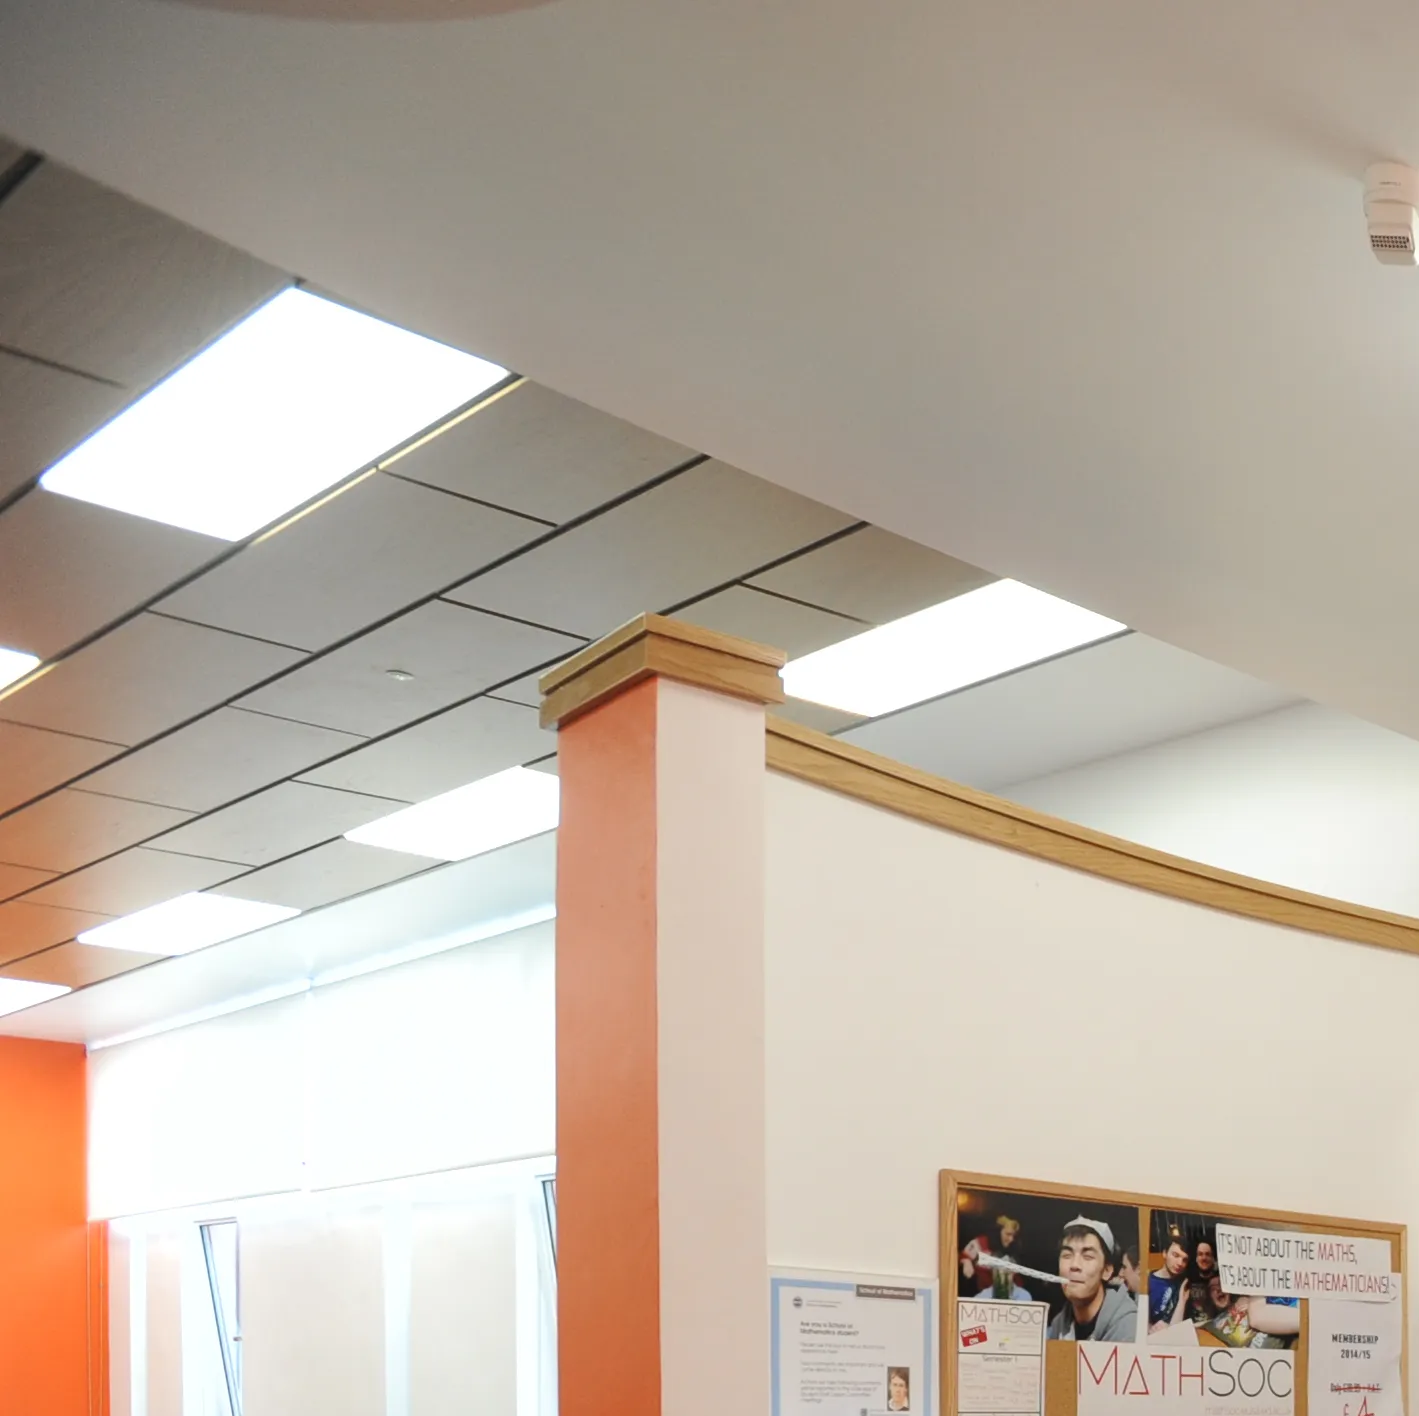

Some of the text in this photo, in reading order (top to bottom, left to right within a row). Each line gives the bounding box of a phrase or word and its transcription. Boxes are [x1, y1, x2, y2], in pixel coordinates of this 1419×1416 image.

[1235, 1236, 1253, 1256] NOT
[1255, 1237, 1292, 1259] ABOUT
[1294, 1240, 1315, 1260] THE
[1317, 1242, 1358, 1264] MATHS,
[1237, 1265, 1268, 1289] ABOUT
[1270, 1268, 1292, 1290] THE
[1293, 1270, 1390, 1295] MATHEMATICIANS!
[1331, 1333, 1379, 1344] MEMBERSHIP
[1340, 1348, 1371, 1360] 2014/15
